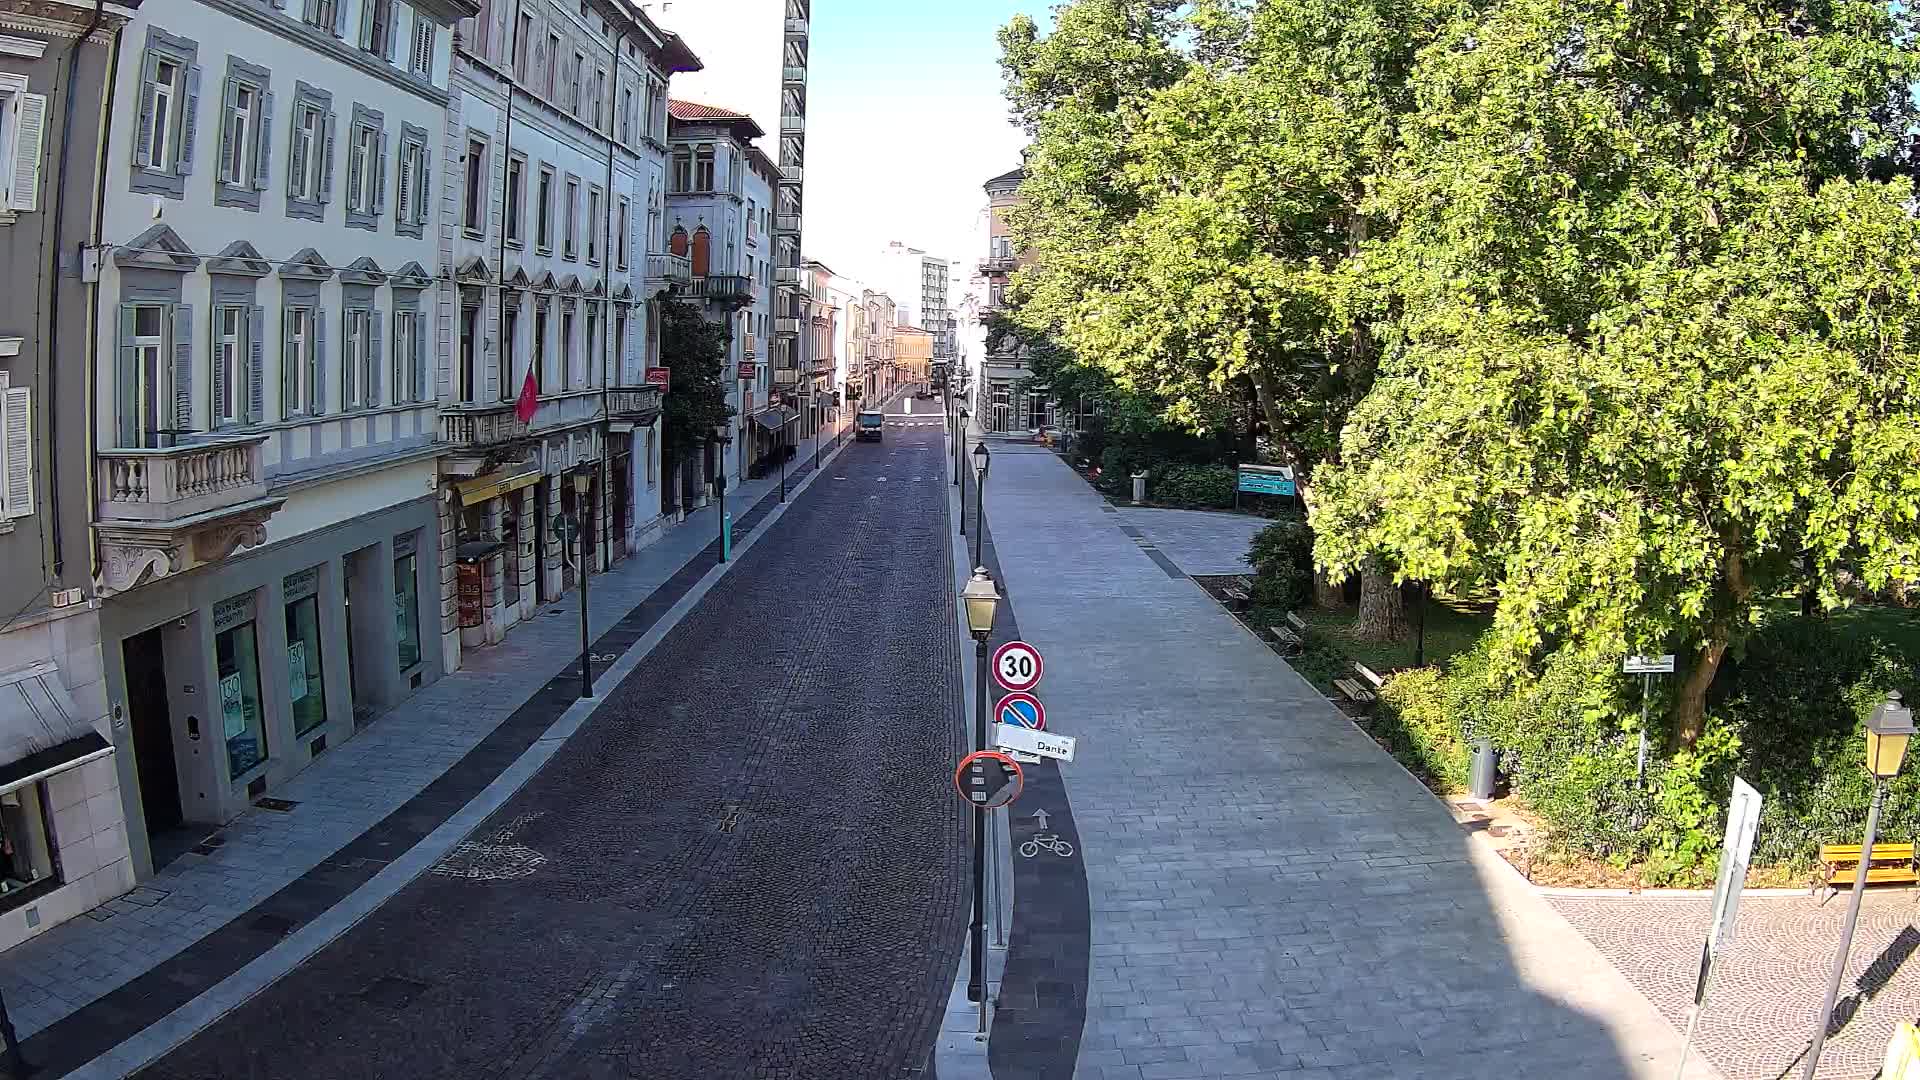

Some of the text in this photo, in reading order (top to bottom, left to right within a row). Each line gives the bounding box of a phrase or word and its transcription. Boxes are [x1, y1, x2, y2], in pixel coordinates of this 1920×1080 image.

[1005, 655, 1031, 677] 30
[221, 676, 239, 698] 130
[1037, 741, 1068, 755] Dante
